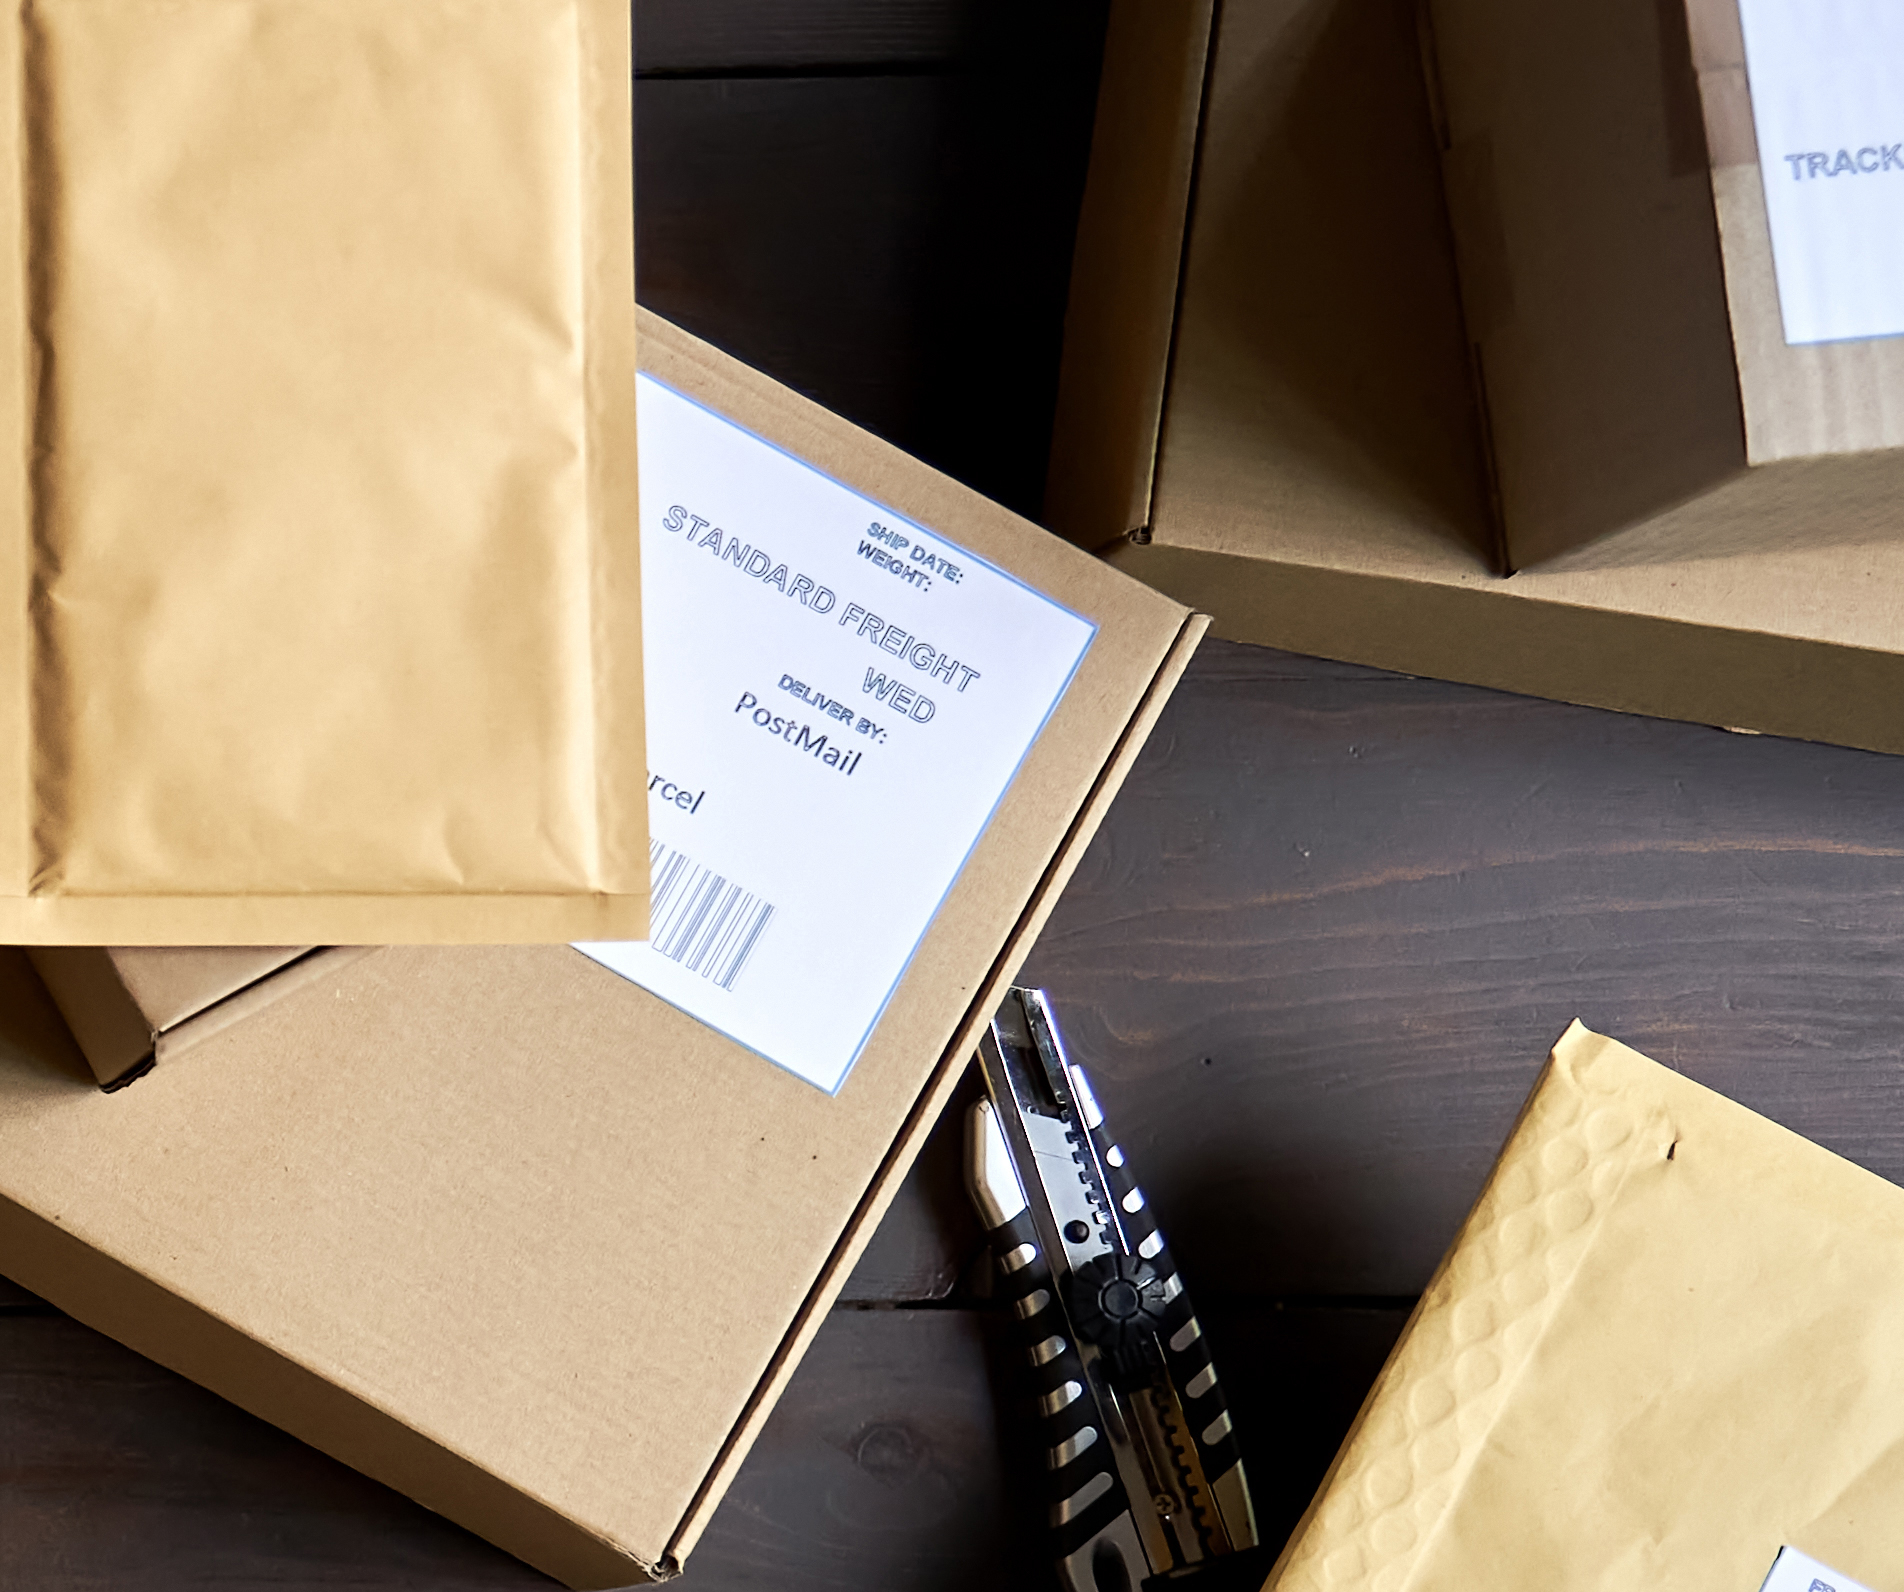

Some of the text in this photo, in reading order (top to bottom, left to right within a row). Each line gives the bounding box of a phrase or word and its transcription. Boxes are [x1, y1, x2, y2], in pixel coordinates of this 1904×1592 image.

[857, 539, 932, 592] WEIGHT:
[866, 521, 964, 586] SHIP DATE:
[663, 505, 981, 693] STANDARD FREIGHT
[778, 674, 888, 745] DELIVER BY:
[862, 666, 936, 724] WED
[734, 691, 862, 776] PostMail
[647, 769, 706, 815] rcel
